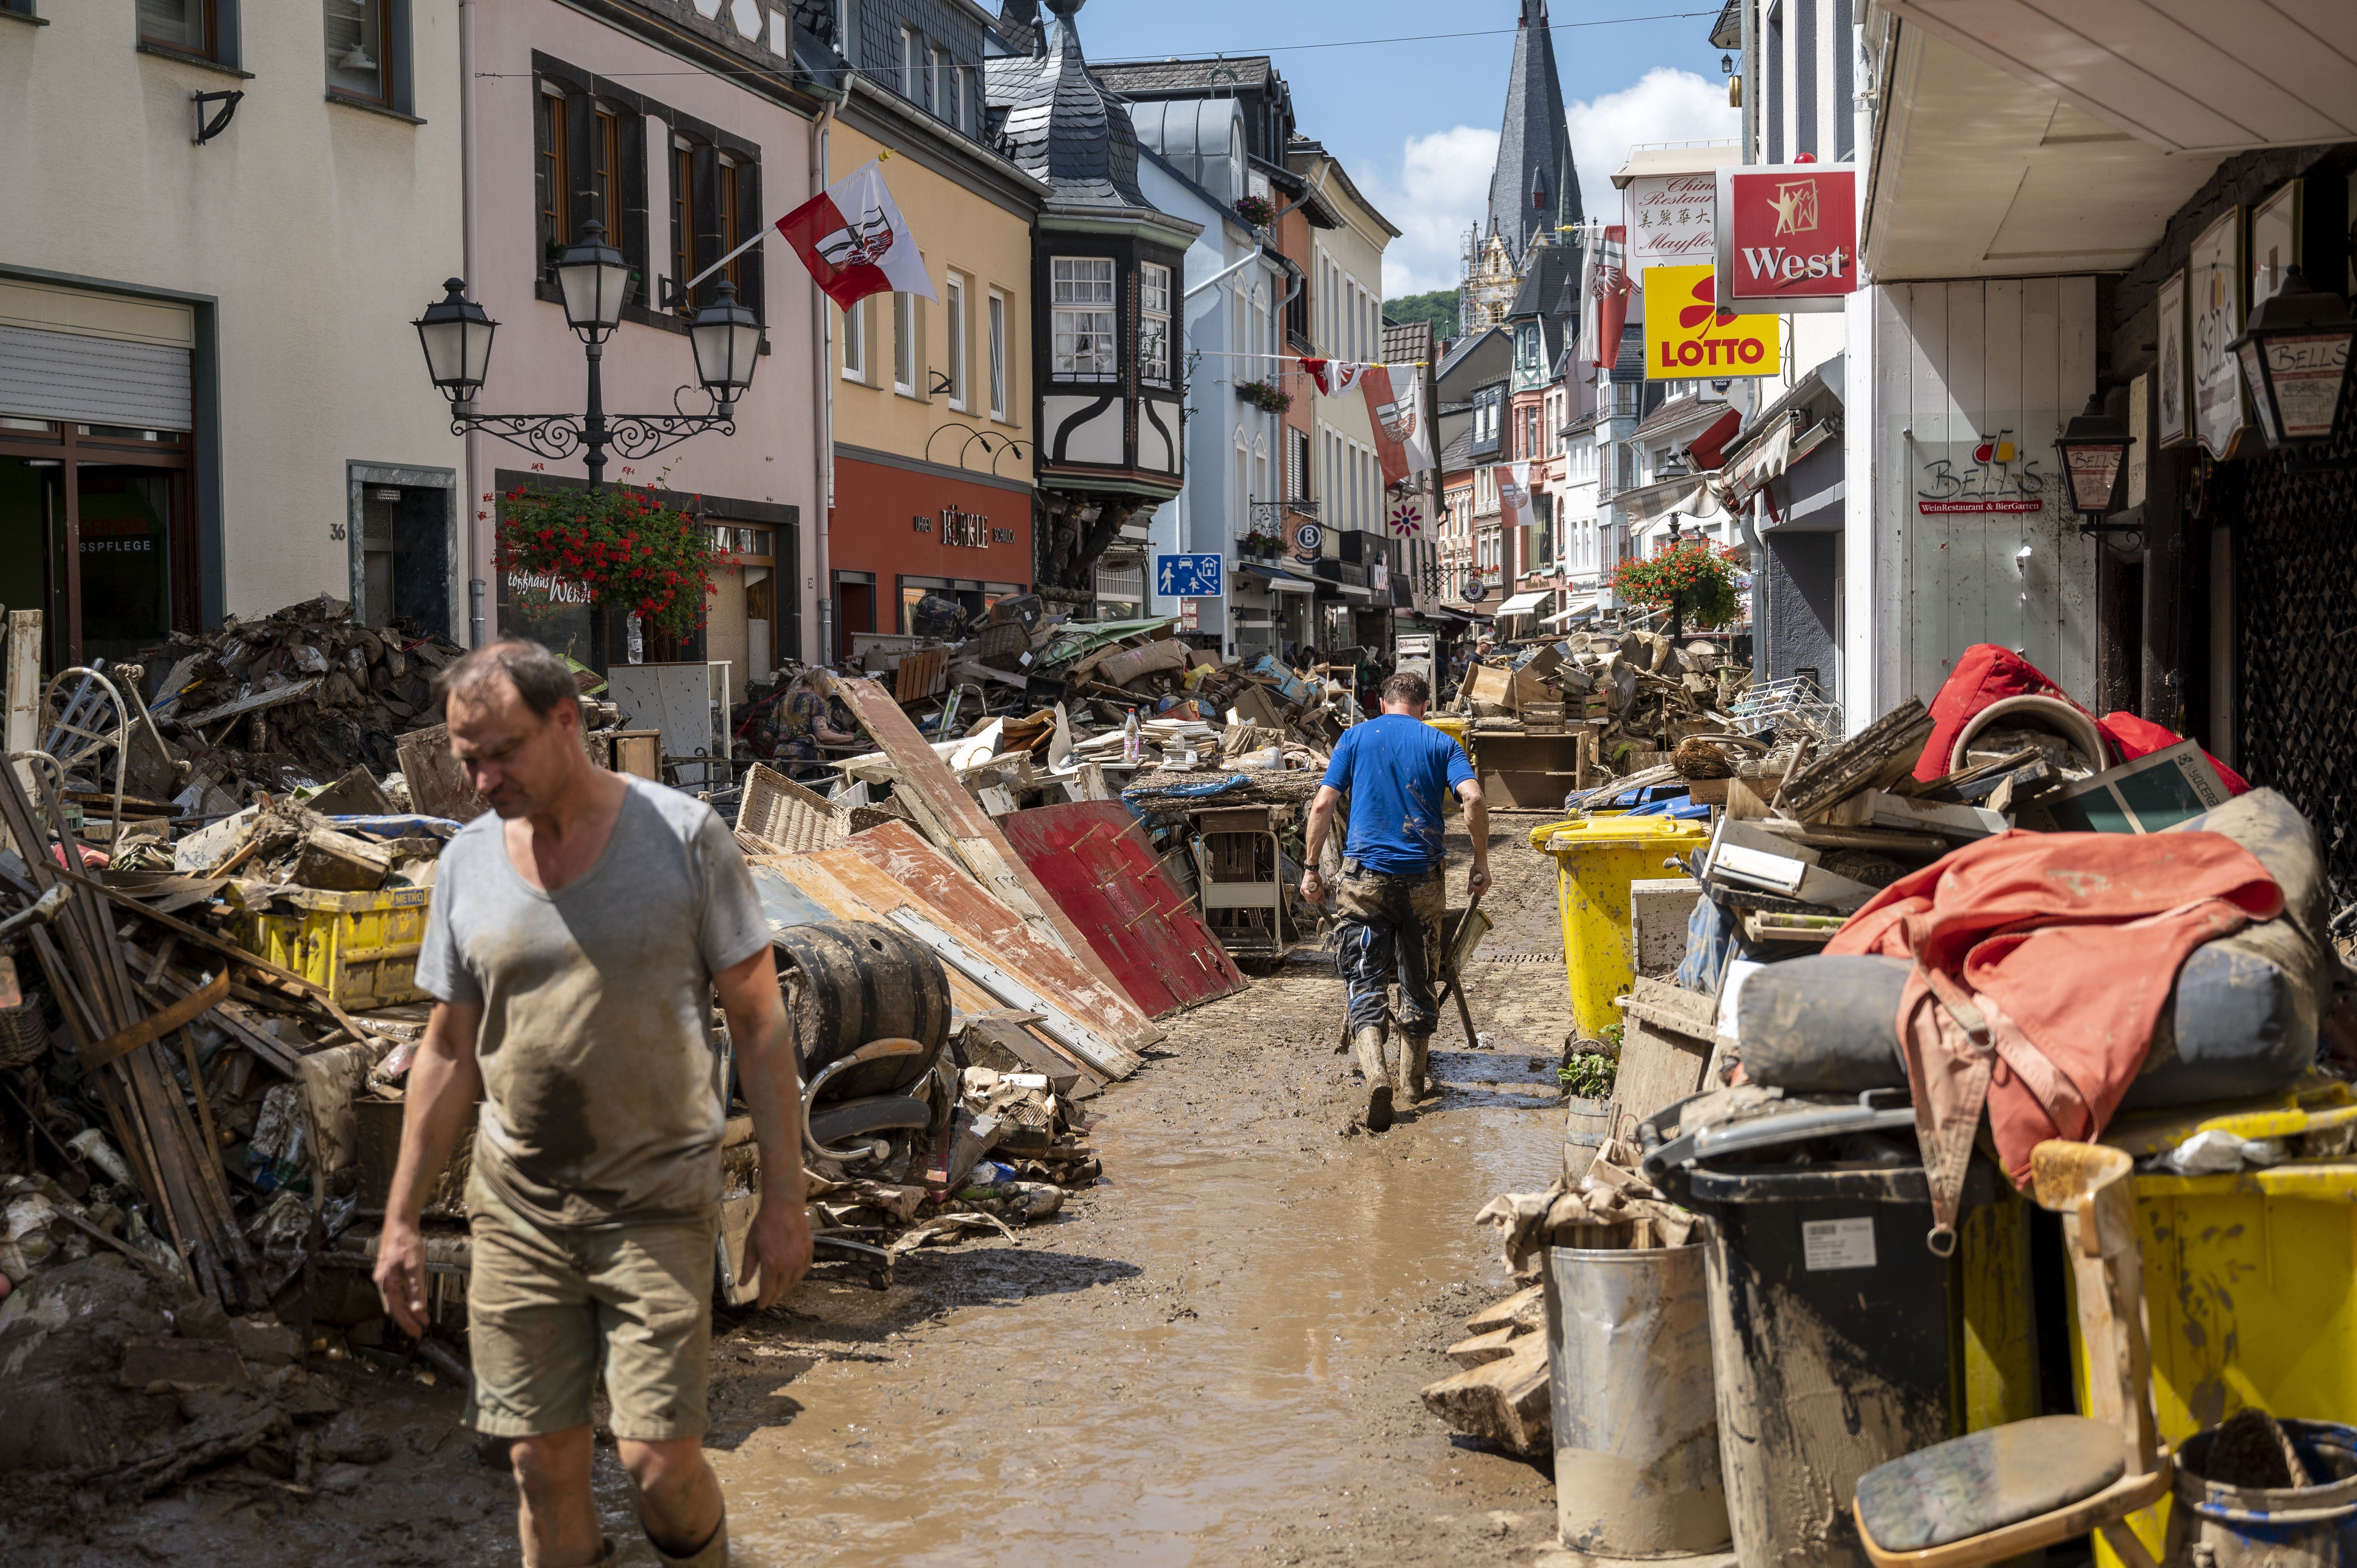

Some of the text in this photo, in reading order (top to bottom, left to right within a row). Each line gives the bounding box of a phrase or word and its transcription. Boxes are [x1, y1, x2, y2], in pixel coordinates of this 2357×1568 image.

[1639, 191, 1715, 206] Restaur
[1742, 246, 1845, 279] West
[1661, 338, 1765, 367] LOTTO
[1921, 503, 1984, 512] WeinRestaurant
[330, 524, 346, 540] 36
[914, 505, 1015, 548] UHREN BÜRKLE SCHMUCK
[62, 540, 150, 553] SSPFLEGE
[508, 569, 549, 595] toffhaus
